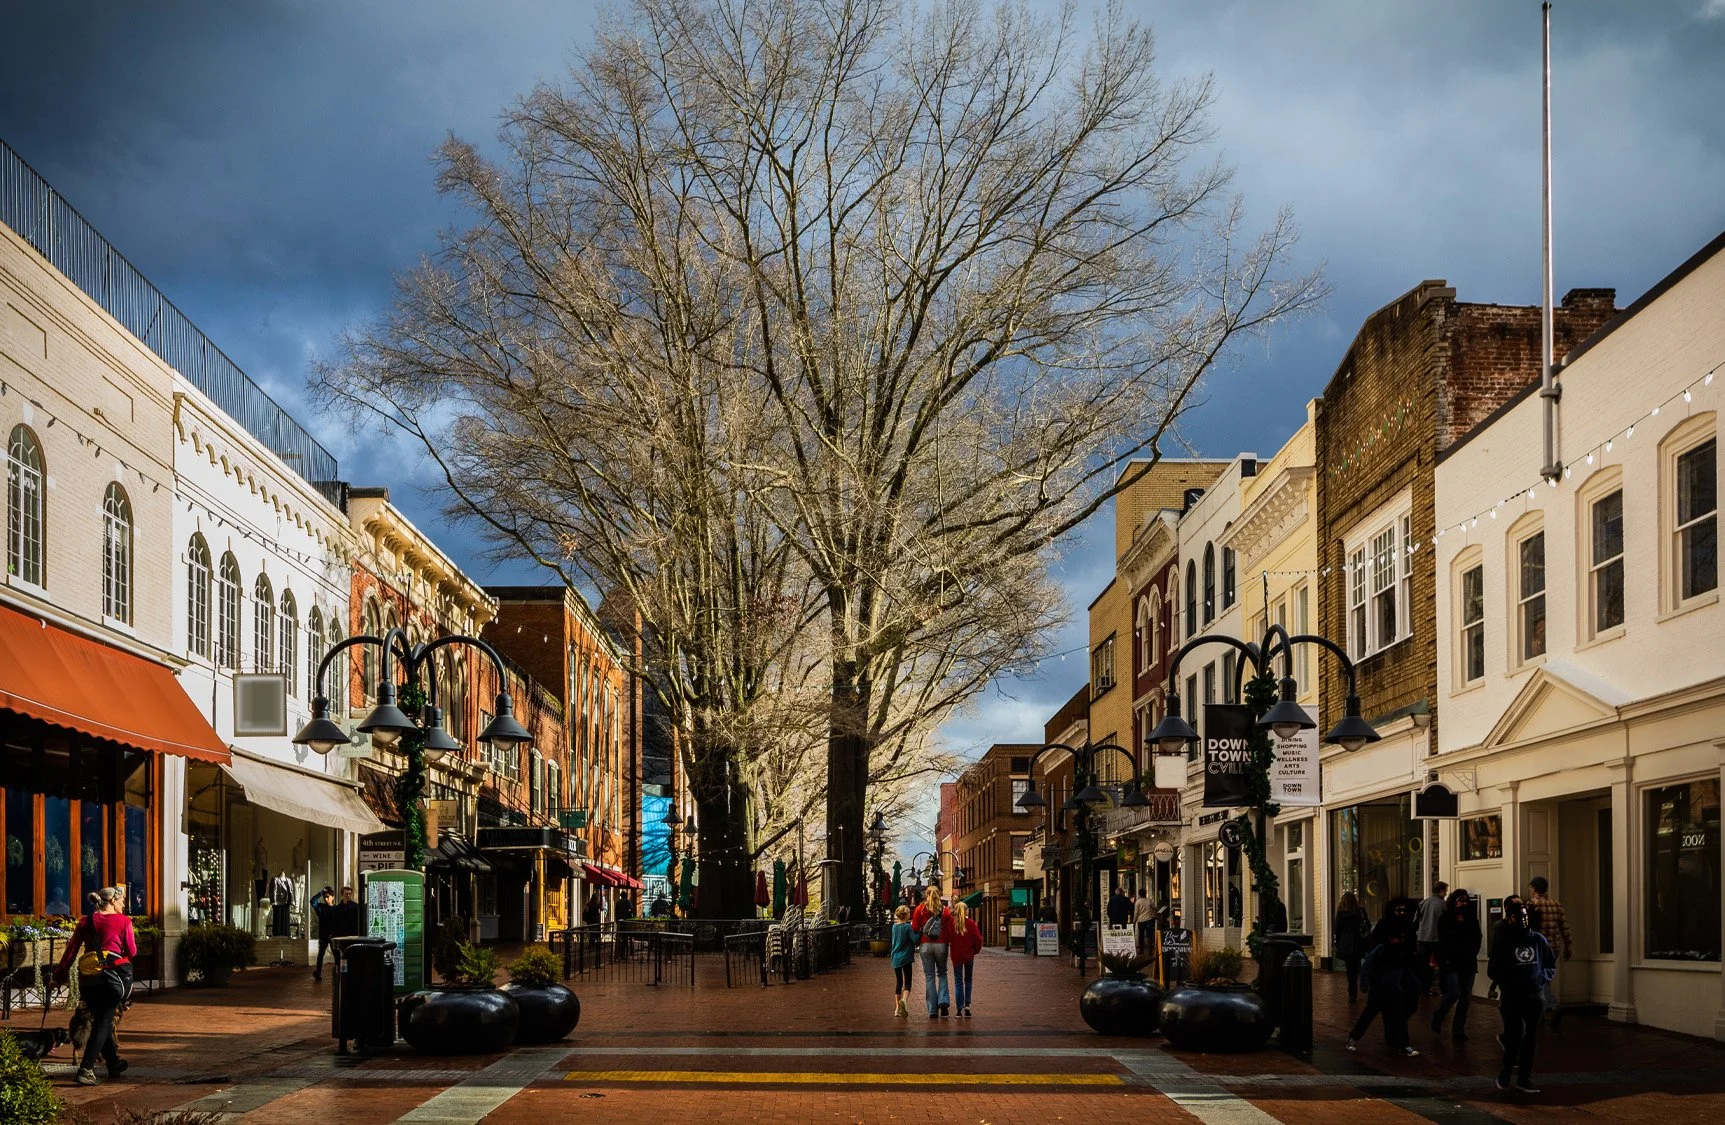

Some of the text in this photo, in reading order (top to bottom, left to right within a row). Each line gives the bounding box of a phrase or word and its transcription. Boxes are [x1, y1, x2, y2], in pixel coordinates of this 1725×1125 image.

[1208, 750, 1252, 762] TOWN
[362, 839, 374, 847] 4th
[377, 862, 396, 871] PIE
